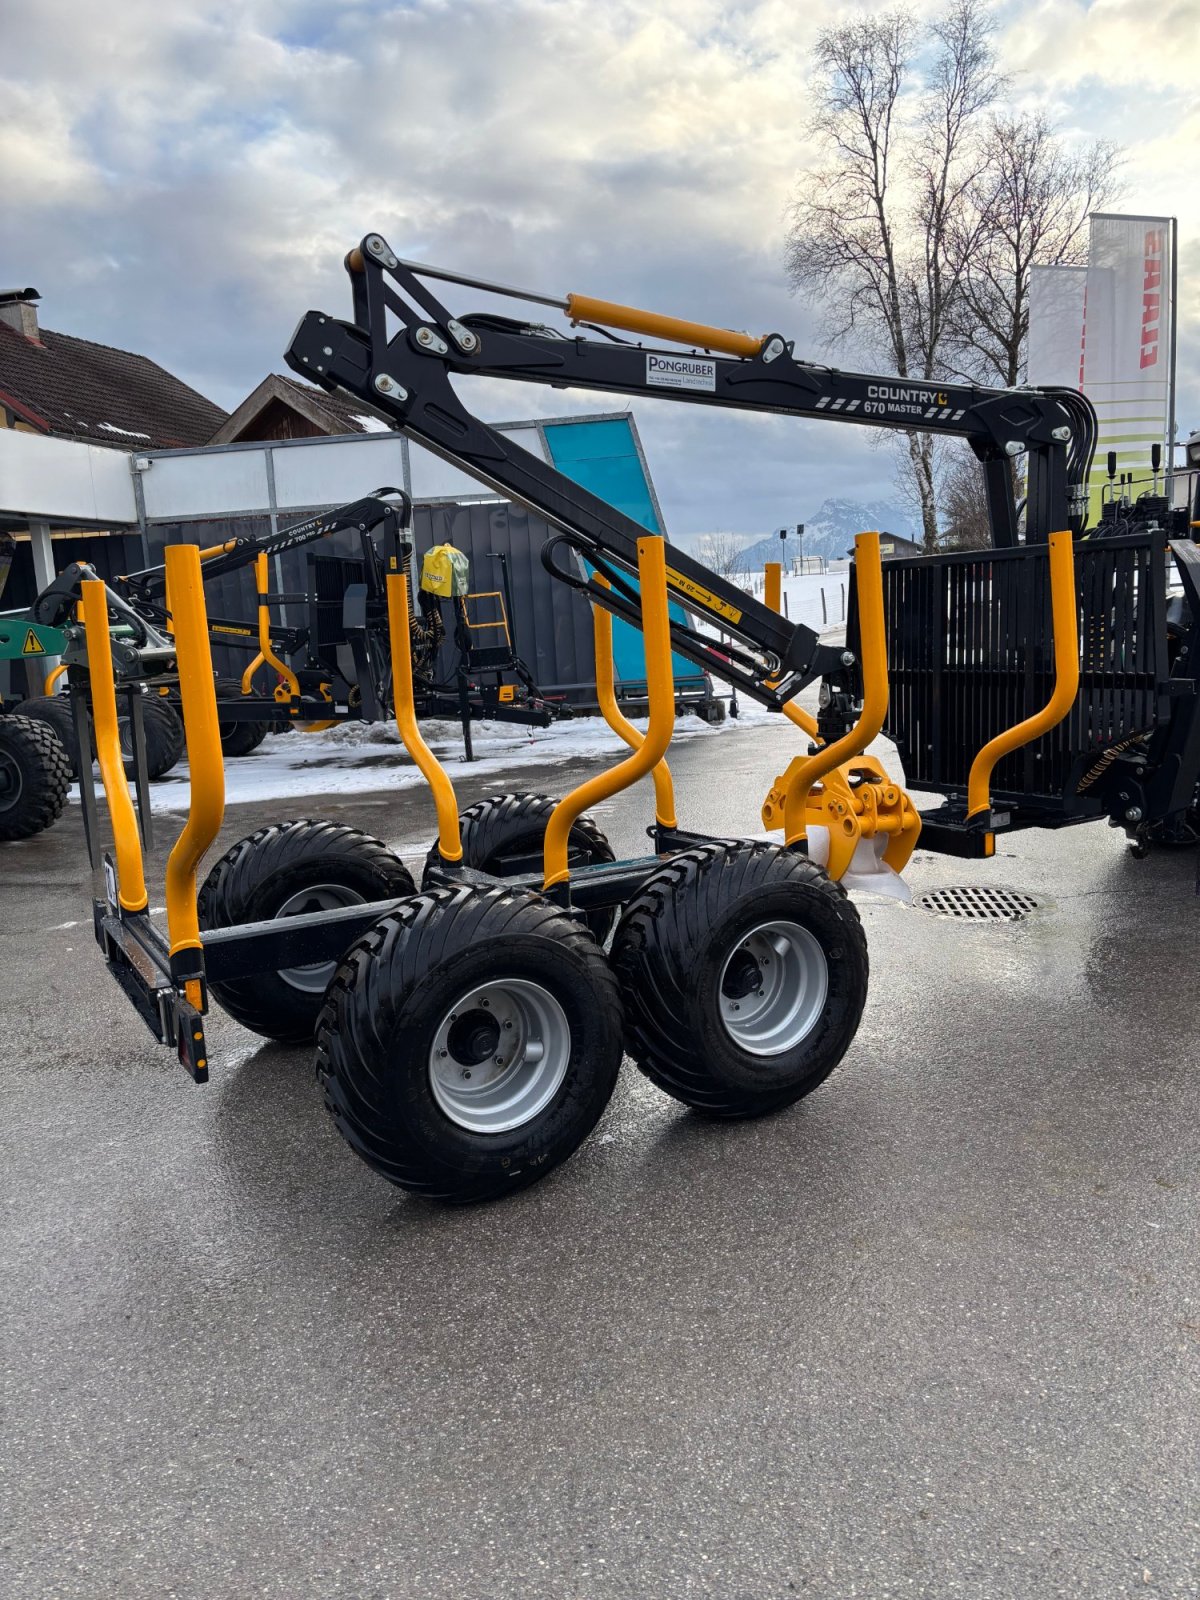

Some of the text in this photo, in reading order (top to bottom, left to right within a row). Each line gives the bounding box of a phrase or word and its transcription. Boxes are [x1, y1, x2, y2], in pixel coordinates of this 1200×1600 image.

[648, 356, 714, 376] PONGRUBER
[867, 385, 937, 404] COUNTRY
[864, 401, 922, 415] 670 MASTER
[289, 522, 315, 536] COUNTRY
